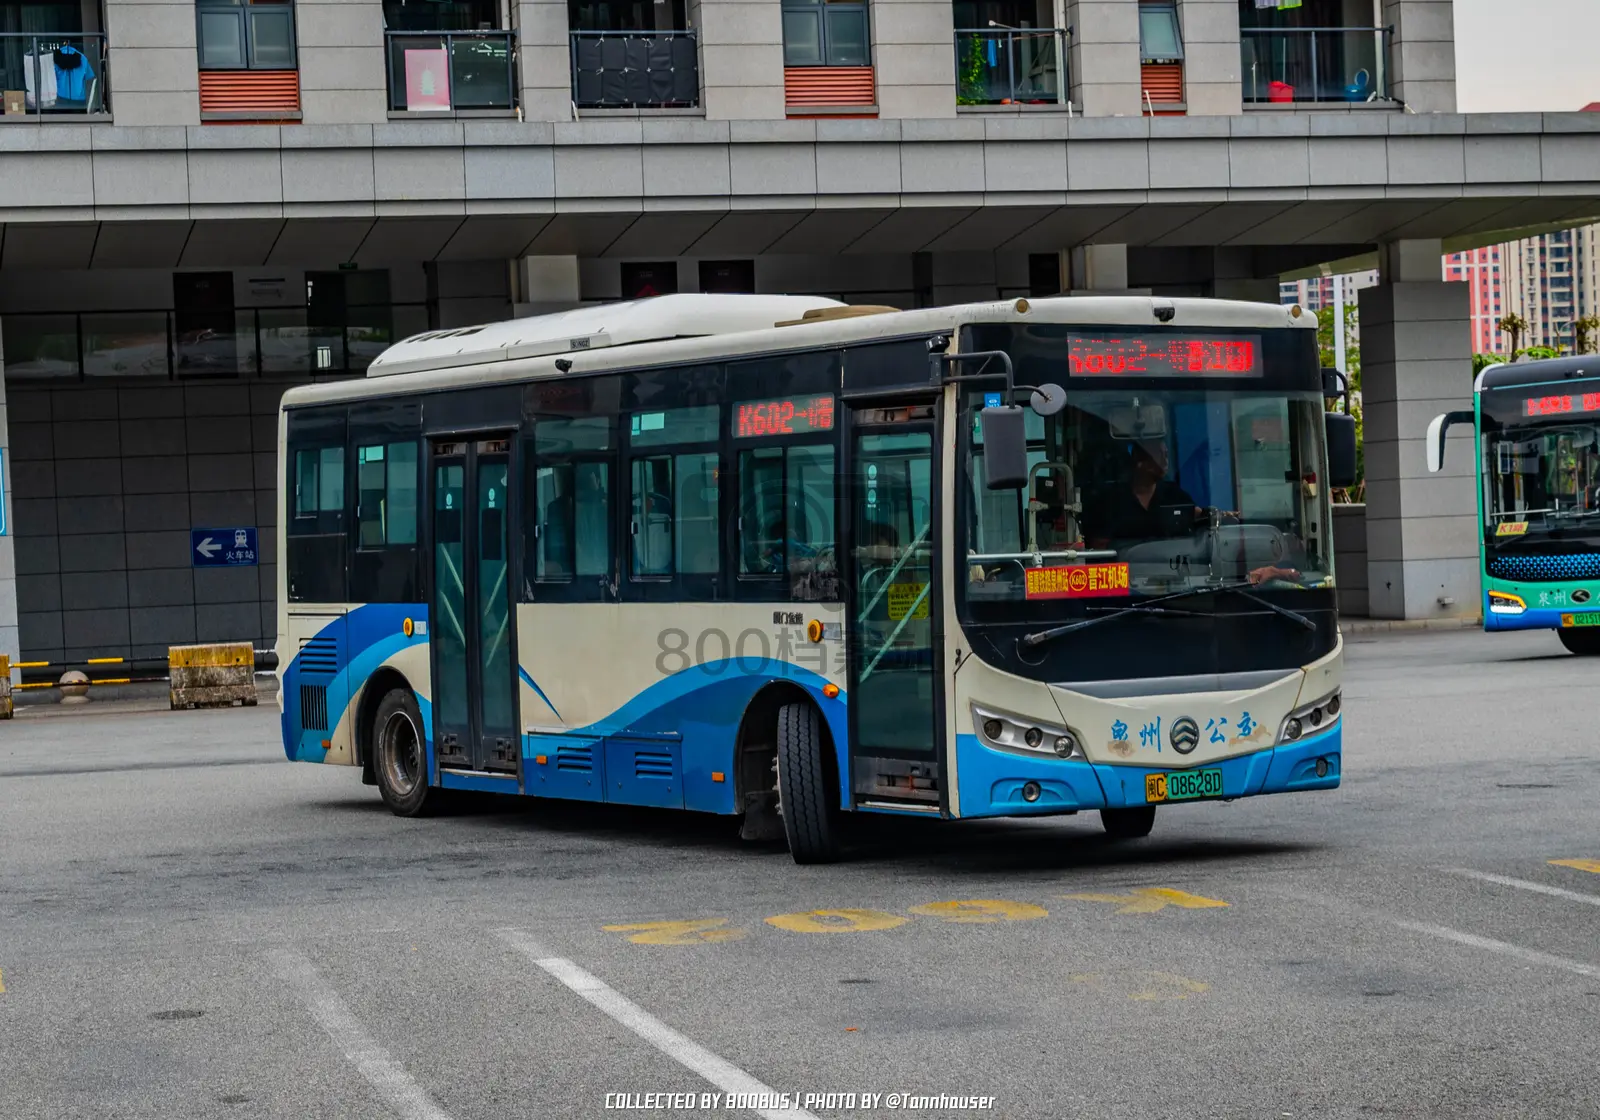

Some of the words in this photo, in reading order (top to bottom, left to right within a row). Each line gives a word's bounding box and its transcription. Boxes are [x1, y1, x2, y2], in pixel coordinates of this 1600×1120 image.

[738, 401, 794, 436] K602
[226, 550, 254, 559] 火车站
[1088, 565, 1128, 591] 晋江机场
[1539, 590, 1566, 606] 泉州
[1111, 716, 1161, 752] 泉州
[1205, 711, 1257, 743] 公交
[1170, 772, 1222, 796] 08628D
